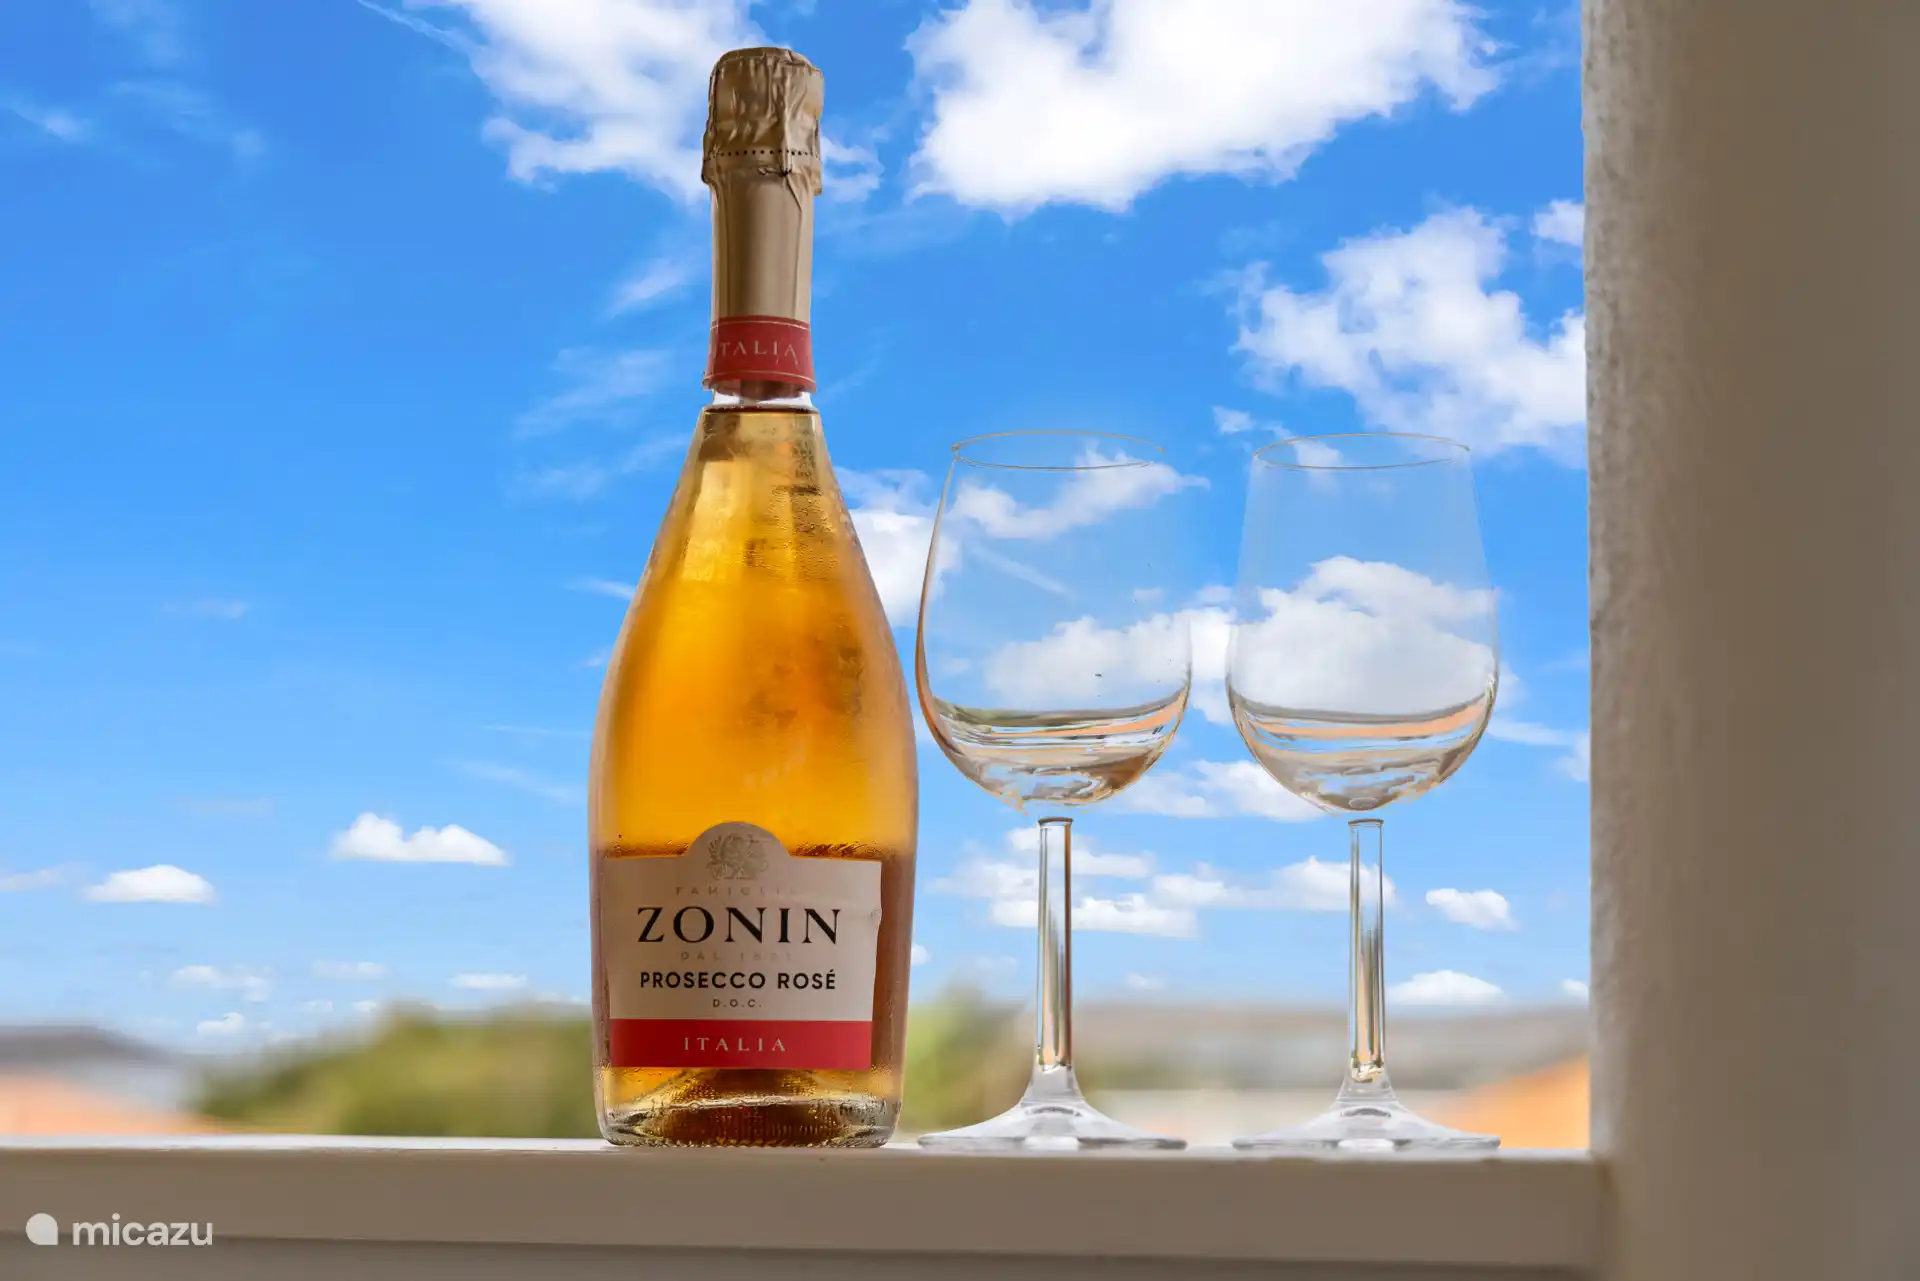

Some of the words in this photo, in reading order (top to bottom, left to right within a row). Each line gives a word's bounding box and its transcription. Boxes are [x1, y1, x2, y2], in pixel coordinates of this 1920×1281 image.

[719, 340, 800, 367] TALIA
[674, 886, 802, 897] FAMIGLI
[637, 905, 842, 945] ZONIN
[640, 971, 766, 989] PROSECCO
[777, 969, 837, 990] ROSÉ
[712, 998, 763, 1008] D.O.C.
[684, 1037, 787, 1052] ITALIA
